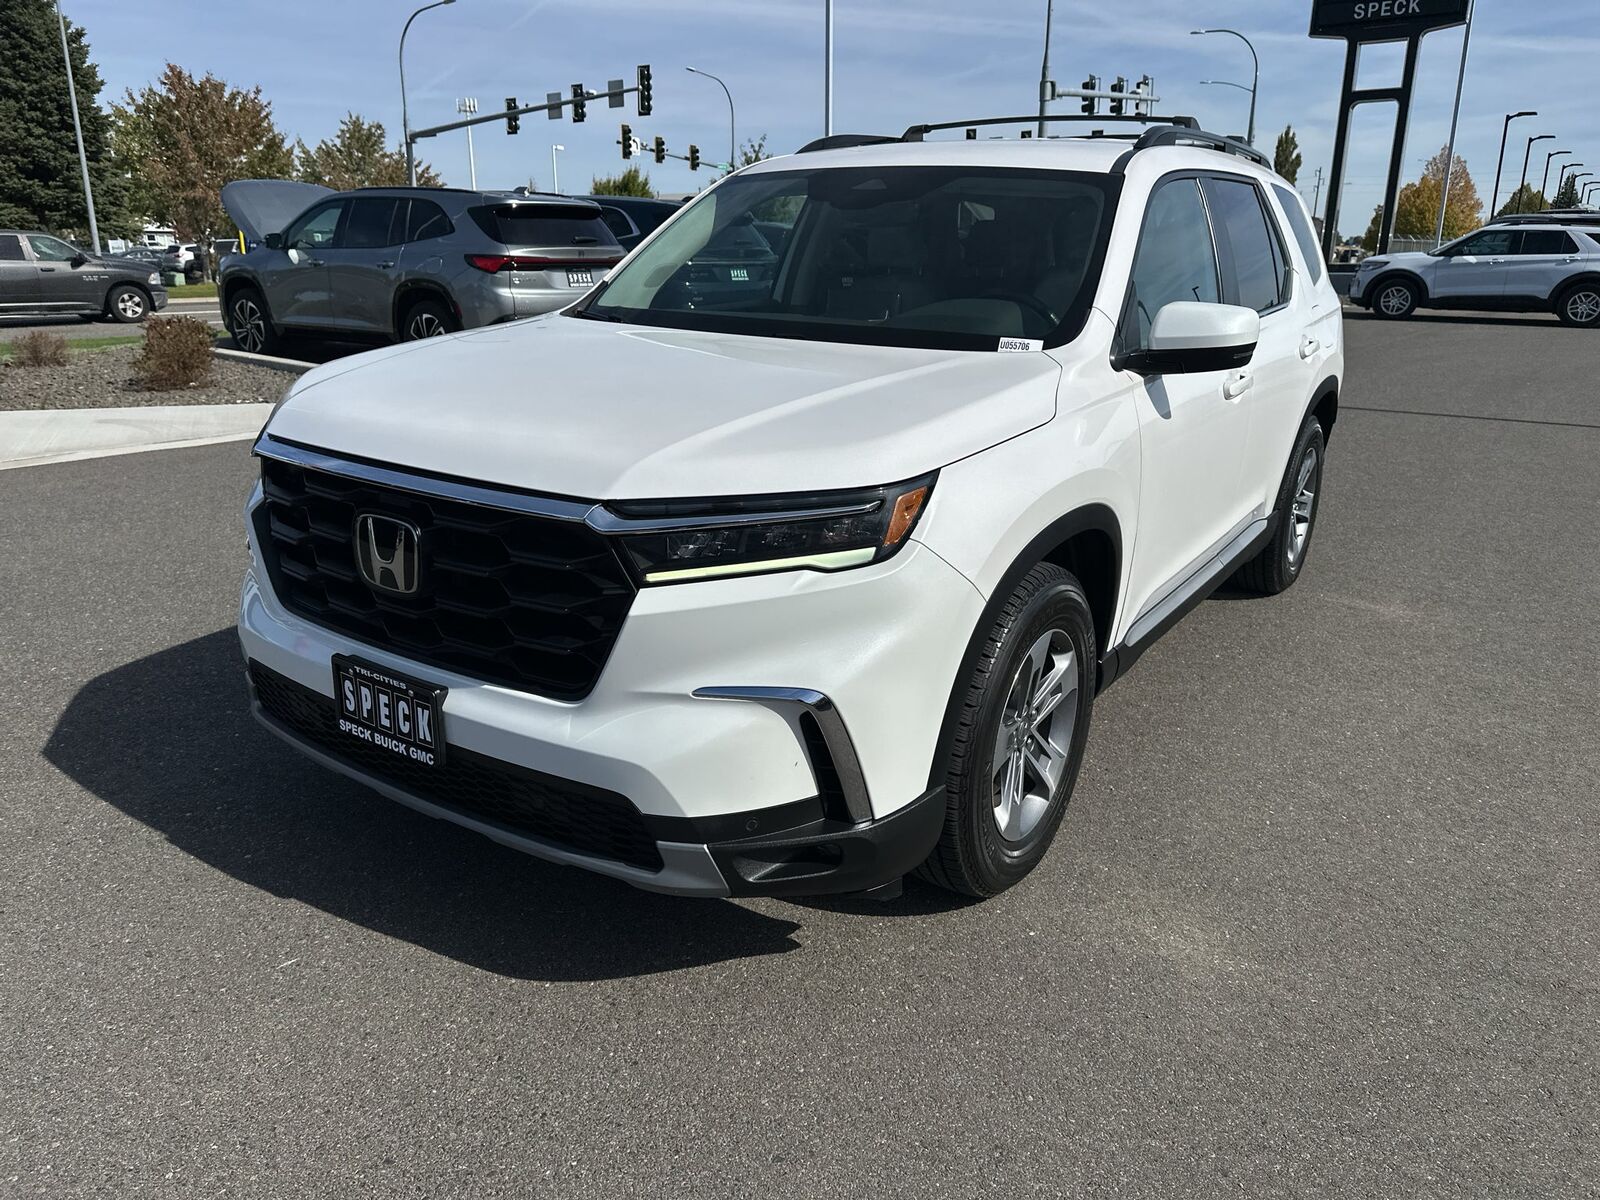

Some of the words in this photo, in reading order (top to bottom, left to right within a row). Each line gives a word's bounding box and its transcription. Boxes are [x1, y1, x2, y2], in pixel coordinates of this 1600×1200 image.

[1354, 0, 1420, 19] SPECK
[1000, 341, 1030, 351] U055706
[354, 666, 407, 690] TRI-CITIES
[344, 680, 432, 742] SPECK
[339, 719, 372, 742] SPECK
[374, 732, 407, 756] BUICK
[409, 747, 434, 765] GMC
